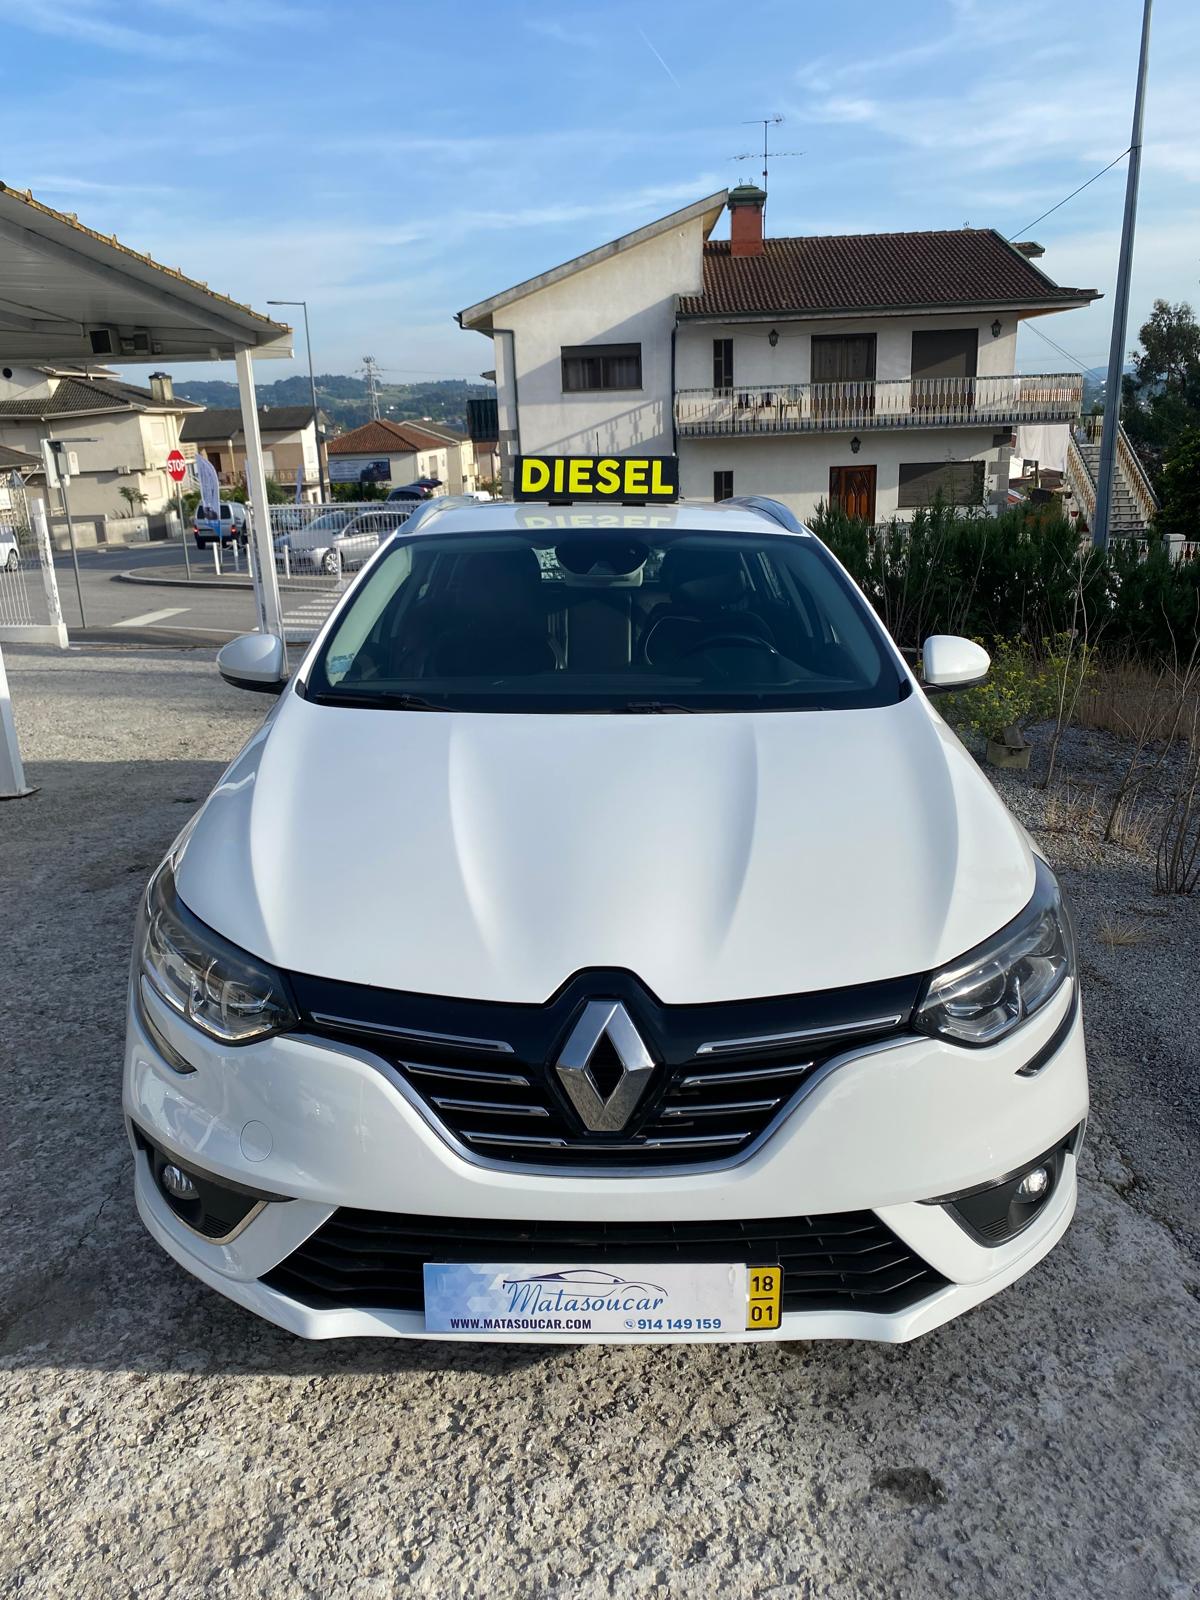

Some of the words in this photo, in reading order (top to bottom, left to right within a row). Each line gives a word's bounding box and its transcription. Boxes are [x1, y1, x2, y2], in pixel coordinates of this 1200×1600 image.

[167, 459, 185, 472] STOP
[521, 459, 674, 494] DIESEL
[752, 1275, 774, 1292] 18
[507, 1282, 664, 1315] Matasoucar
[751, 1305, 774, 1322] 01
[450, 1318, 592, 1330] WWW.MATASOUCAR.COM
[637, 1318, 663, 1330] 914
[666, 1318, 693, 1330] 149
[695, 1318, 722, 1330] 159
